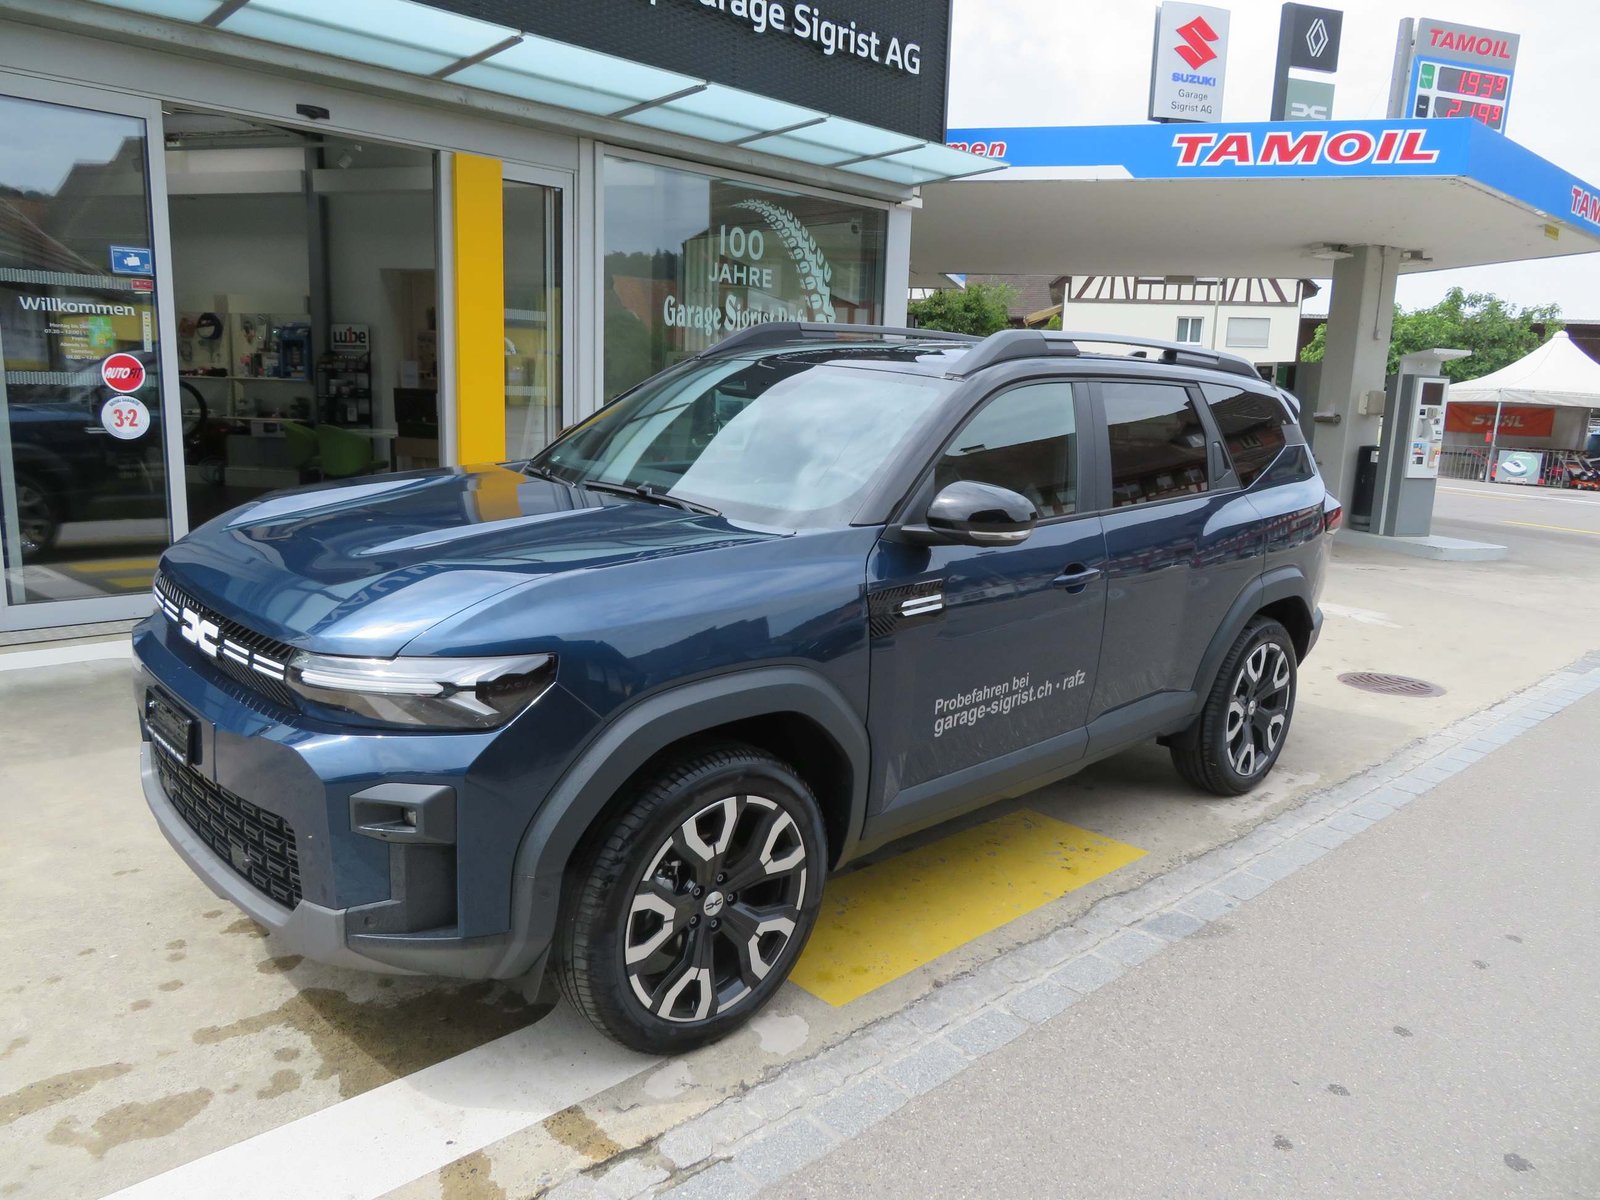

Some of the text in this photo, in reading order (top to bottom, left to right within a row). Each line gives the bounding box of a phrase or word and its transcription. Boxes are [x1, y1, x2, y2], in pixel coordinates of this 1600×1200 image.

[793, 4, 880, 62] Sigrist
[885, 37, 920, 75] AG
[1429, 28, 1511, 59] TAMOIL
[1171, 72, 1217, 87] SUZUKI
[1171, 101, 1213, 114] Sigrist AG
[1178, 88, 1208, 101] Garage
[1172, 129, 1440, 167] TAMOIL
[720, 224, 764, 261] 100
[708, 262, 773, 289] JAHRE
[19, 295, 136, 316] Willkommen
[663, 295, 721, 336] Garage
[105, 367, 143, 379] AUTOFIT
[113, 408, 139, 428] 3+2
[1471, 414, 1524, 428] STHL
[933, 669, 1086, 738] garage-sigrist.ch rafz
[934, 672, 1030, 715] Probefahren bei
